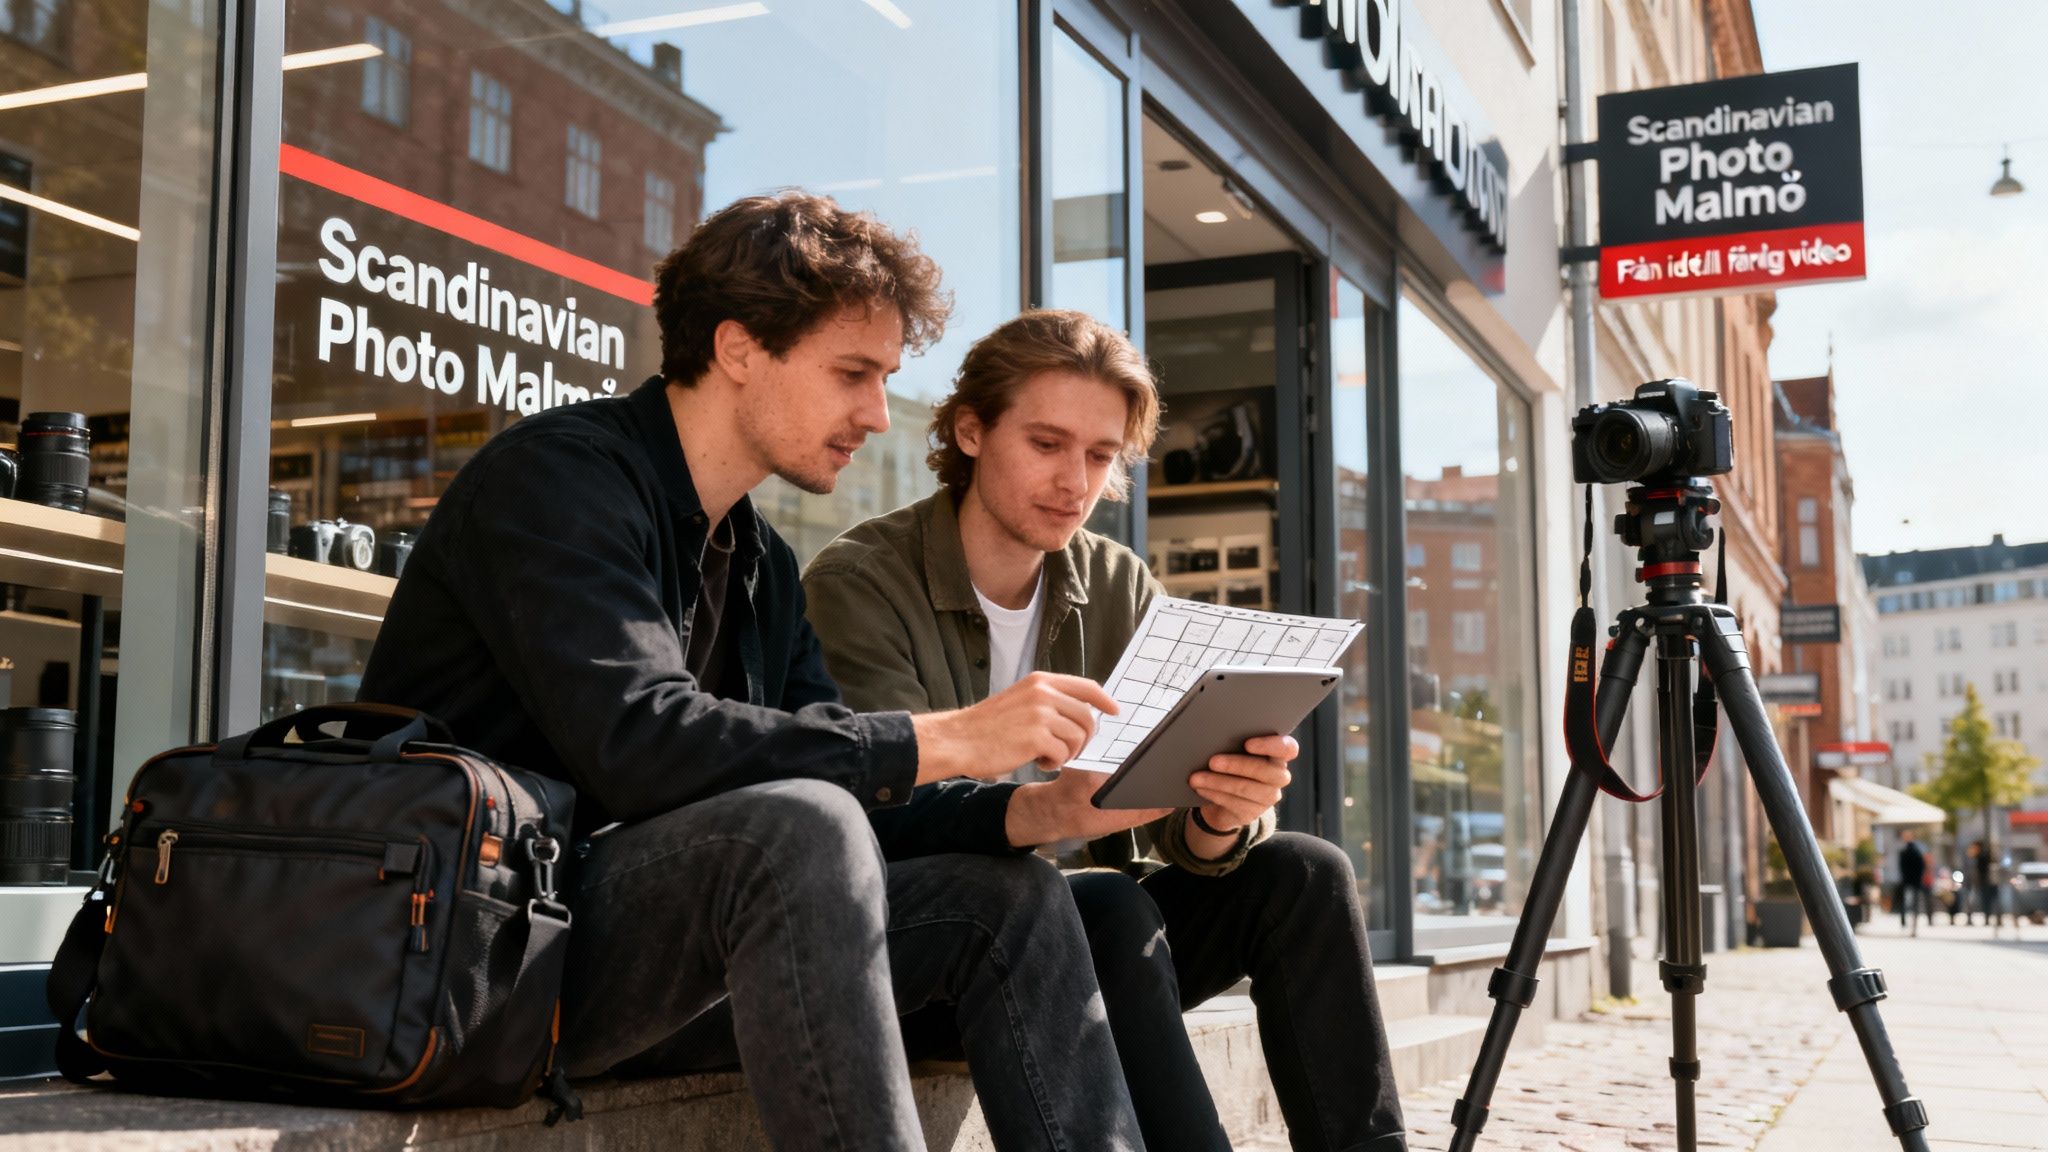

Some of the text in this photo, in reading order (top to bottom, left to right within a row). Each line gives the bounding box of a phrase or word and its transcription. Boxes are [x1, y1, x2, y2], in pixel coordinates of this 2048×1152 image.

[1626, 96, 1835, 146] Scandinavian
[1659, 137, 1794, 184] Photo
[317, 216, 626, 371] Scandinavian
[317, 296, 618, 418] Photo Malm
